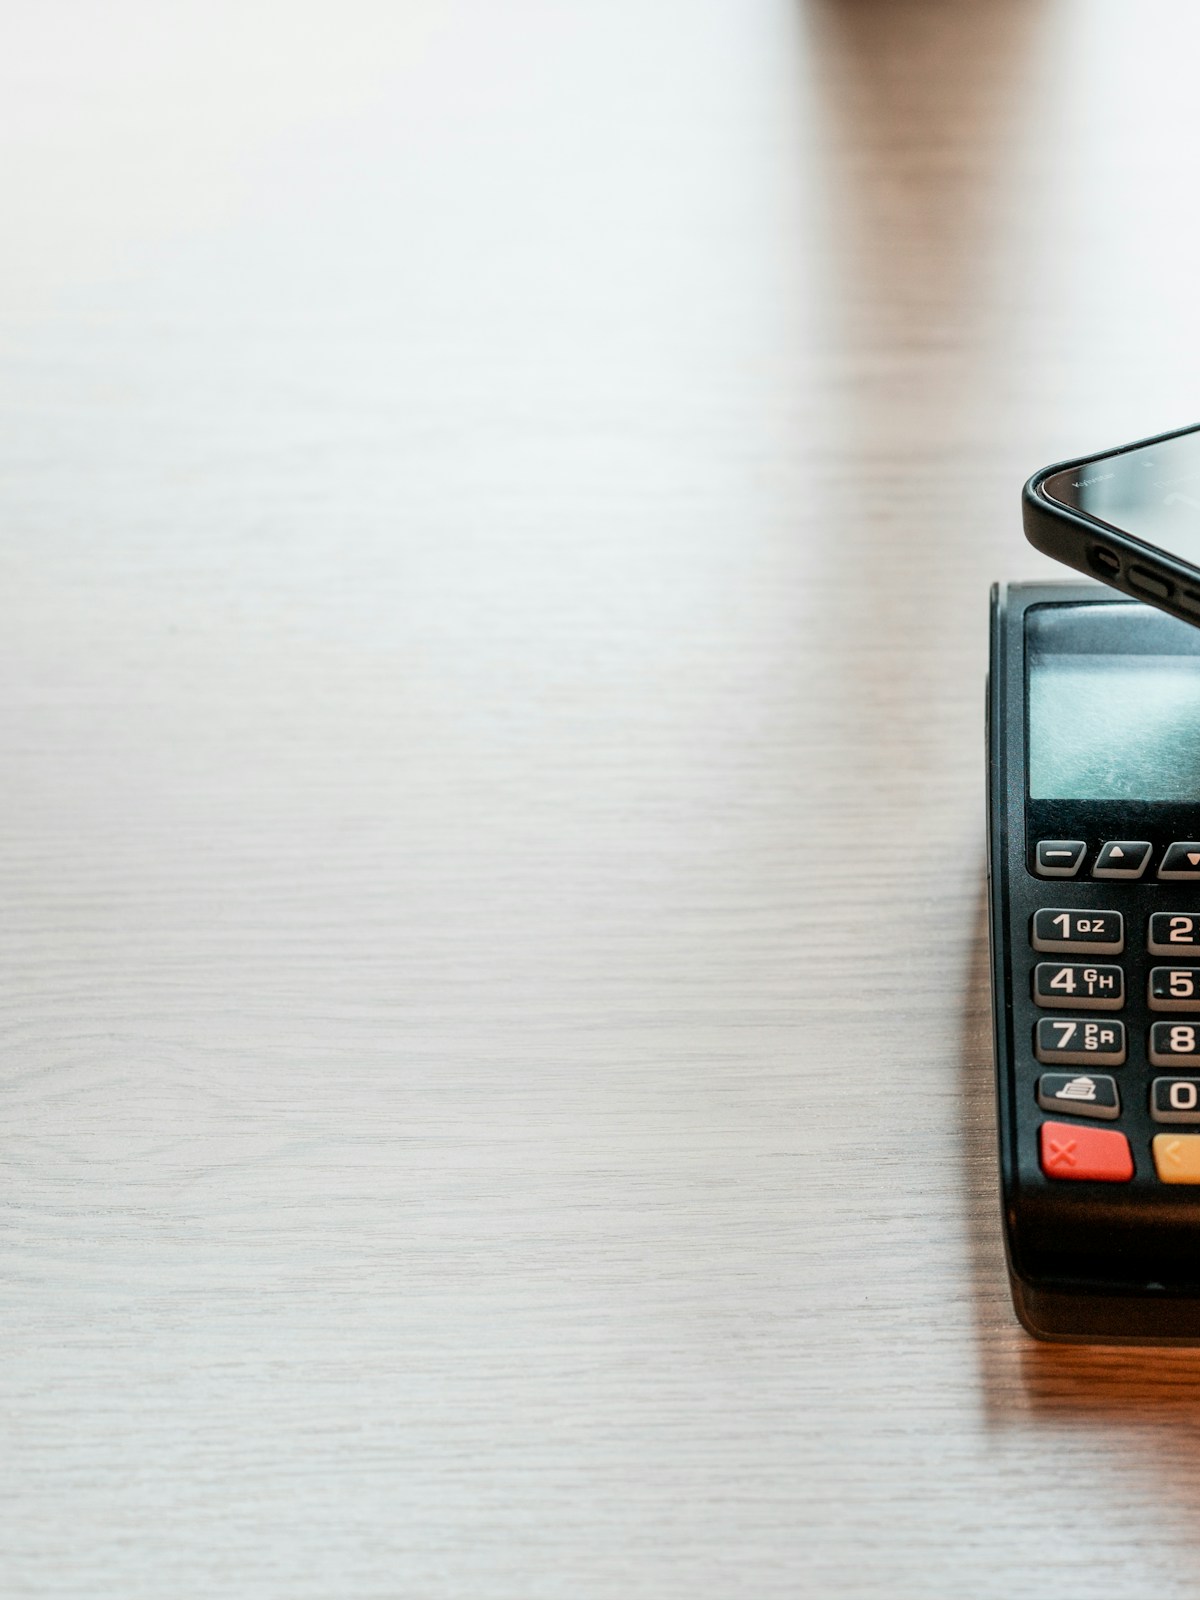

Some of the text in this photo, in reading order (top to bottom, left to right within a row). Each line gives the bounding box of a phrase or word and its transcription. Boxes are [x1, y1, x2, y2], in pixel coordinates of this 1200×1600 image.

[1053, 914, 1104, 937] 1 QZ
[1170, 917, 1193, 941] 2
[1051, 968, 1076, 993] 4
[1170, 972, 1193, 996] 5
[1053, 1020, 1078, 1048] 7
[1171, 1027, 1195, 1052] 8
[1170, 1082, 1197, 1109] 0
